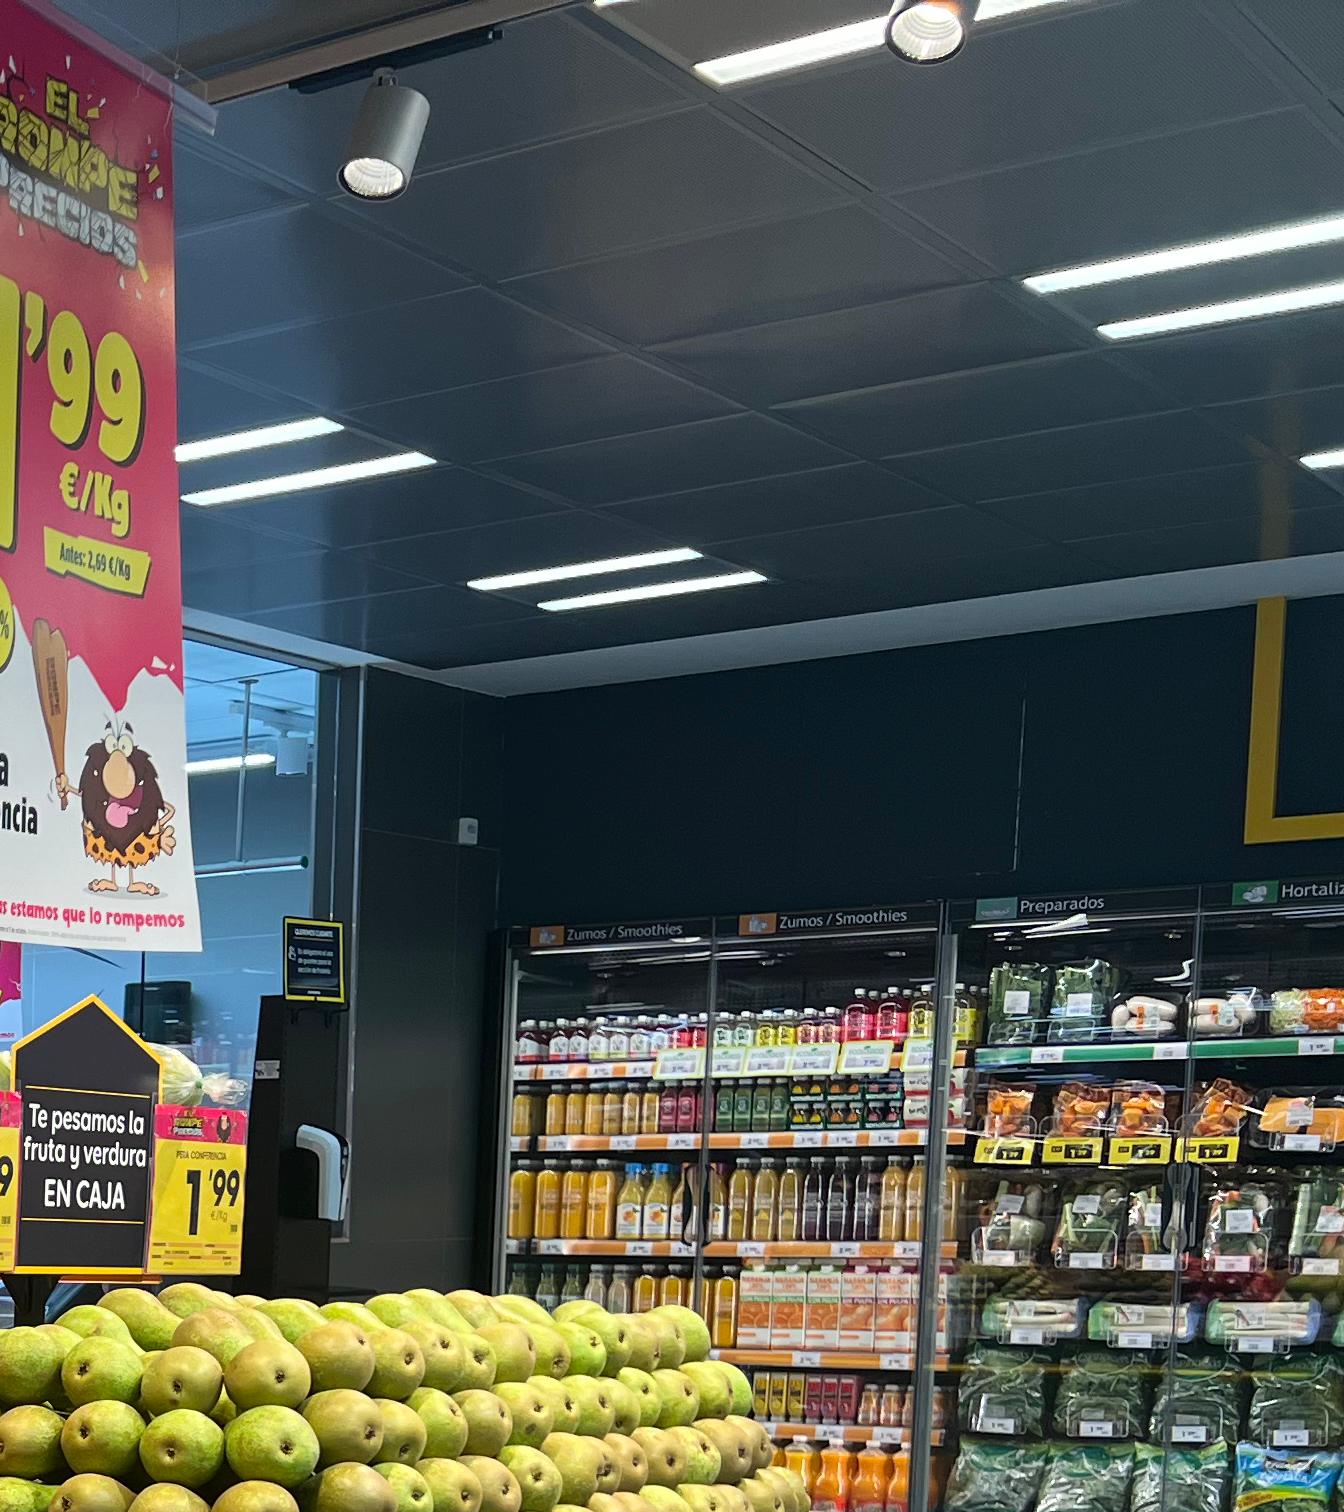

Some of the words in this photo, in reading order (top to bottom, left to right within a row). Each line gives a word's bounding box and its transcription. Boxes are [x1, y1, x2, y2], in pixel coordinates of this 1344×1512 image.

[46, 74, 90, 135] EL
[60, 462, 131, 538] €/Kg
[59, 542, 86, 567] Antes:
[87, 550, 107, 573] 2,69
[108, 556, 131, 581] €/Kg
[10, 903, 59, 921] estamos
[63, 906, 85, 929] que
[89, 906, 102, 924] lo
[106, 912, 185, 932] rompemos
[779, 914, 823, 930] Zumos
[836, 908, 908, 926] Smoothies
[1020, 896, 1105, 915] Preparados
[567, 928, 606, 943] Zumos
[617, 922, 683, 940] Smoothies
[29, 1102, 47, 1129] Te
[51, 1108, 125, 1135] pesamos
[128, 1109, 144, 1135] la
[23, 1135, 65, 1163] fruta
[68, 1144, 80, 1169] y
[84, 1141, 146, 1168] verdura
[44, 1178, 71, 1207] EN
[76, 1180, 125, 1210] CAJA
[186, 1169, 240, 1235] 1'99
